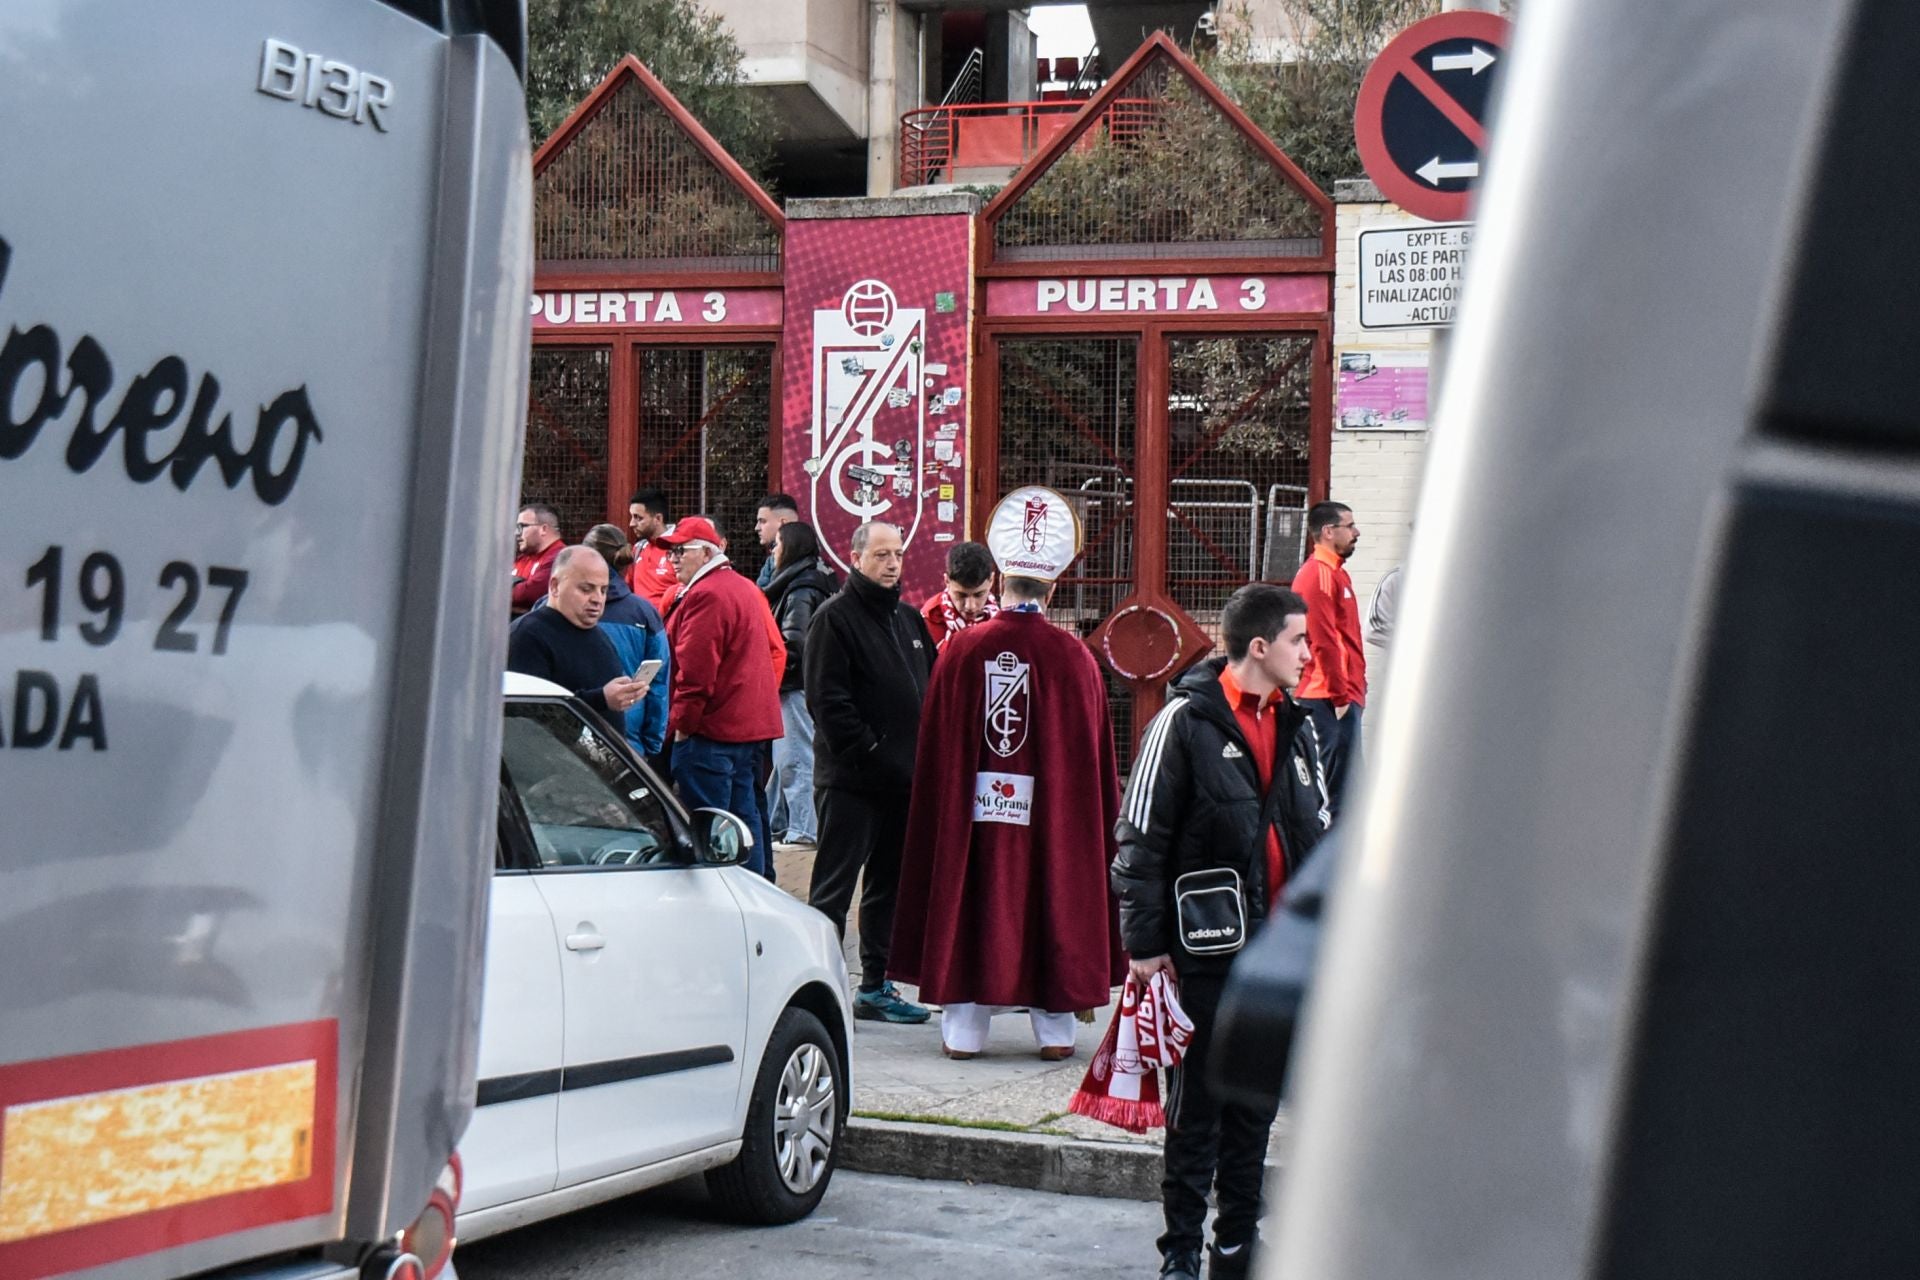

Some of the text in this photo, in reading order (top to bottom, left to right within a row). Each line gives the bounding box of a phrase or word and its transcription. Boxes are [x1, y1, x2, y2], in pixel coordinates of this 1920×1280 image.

[257, 38, 395, 133] B13R
[1375, 249, 1406, 267] DÍAS
[1411, 251, 1428, 265] DE
[1380, 268, 1405, 284] LAS
[1409, 267, 1446, 282] 08:00
[702, 292, 726, 322] 3
[1037, 279, 1266, 311] PUERTA 3
[0, 322, 323, 506] oreno
[1188, 928, 1221, 939] adidas
